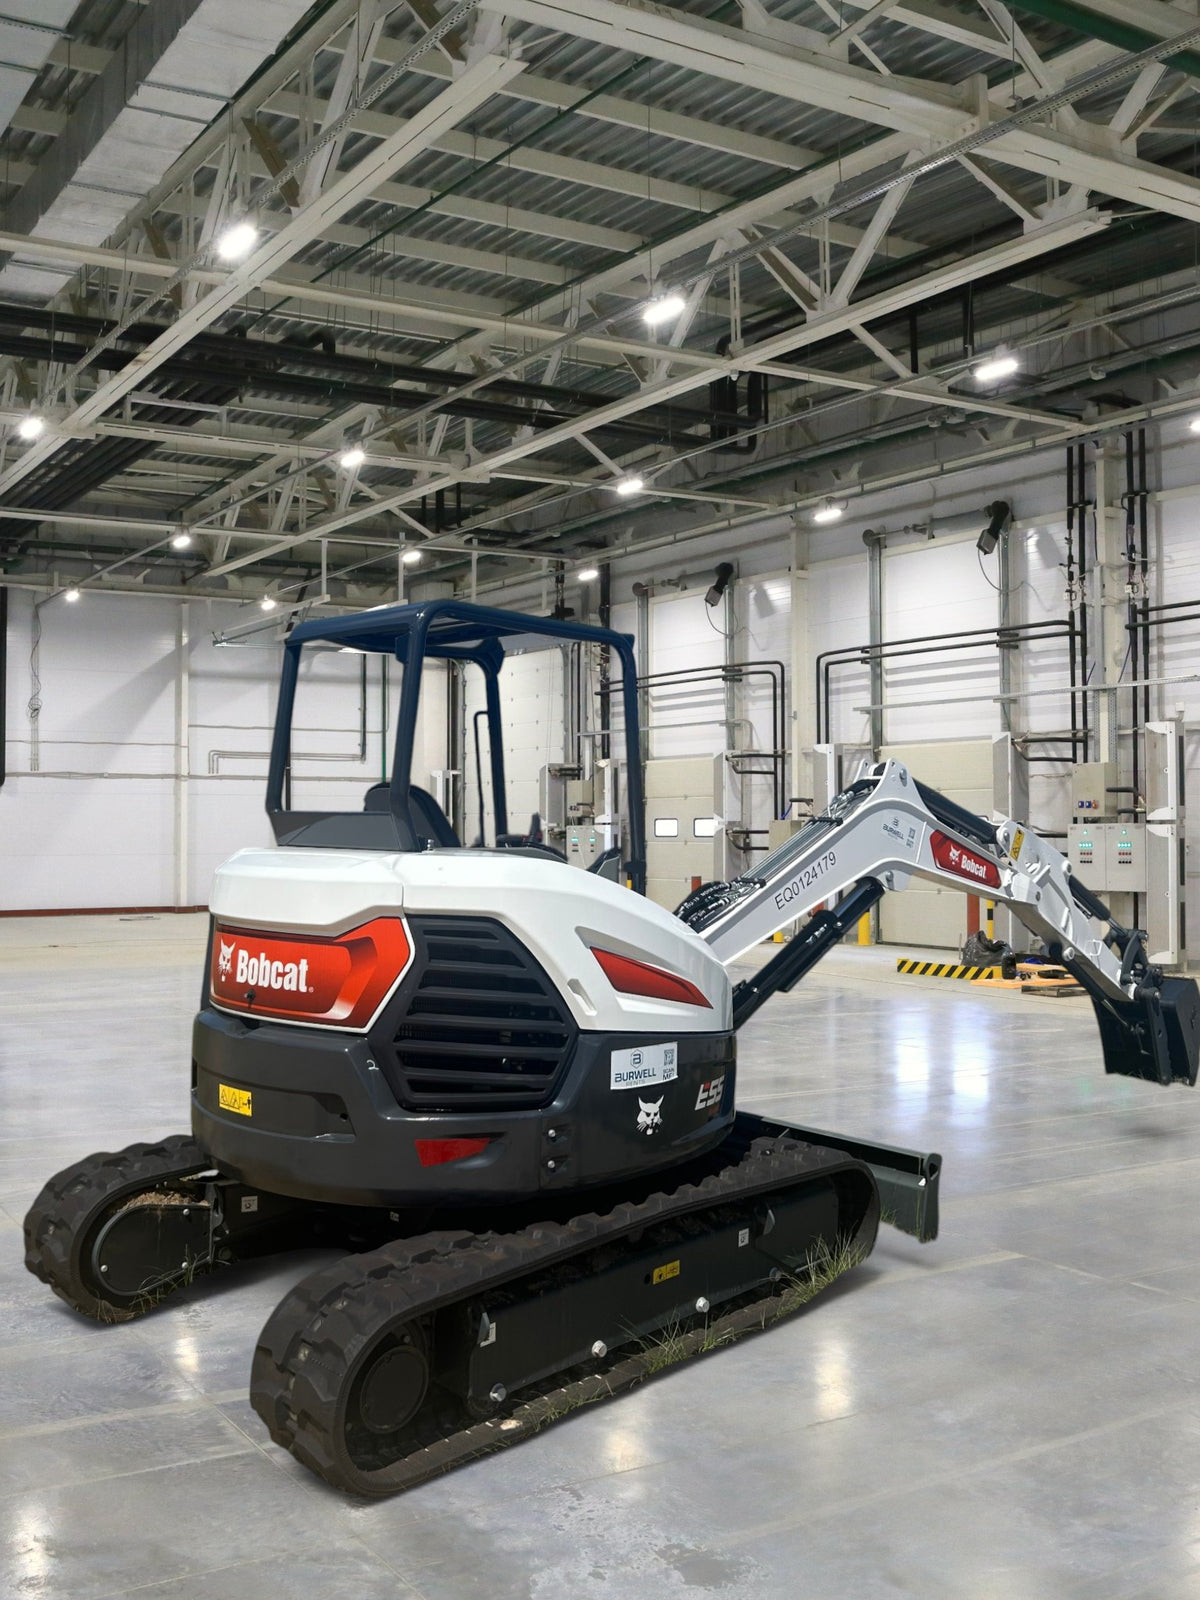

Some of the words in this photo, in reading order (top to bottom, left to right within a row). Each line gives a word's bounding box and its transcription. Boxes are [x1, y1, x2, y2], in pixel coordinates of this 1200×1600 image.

[774, 851, 837, 910] EQ0124179
[961, 854, 987, 879] Bobcat
[235, 949, 309, 993] Bobcat
[614, 1067, 657, 1083] BURWELL
